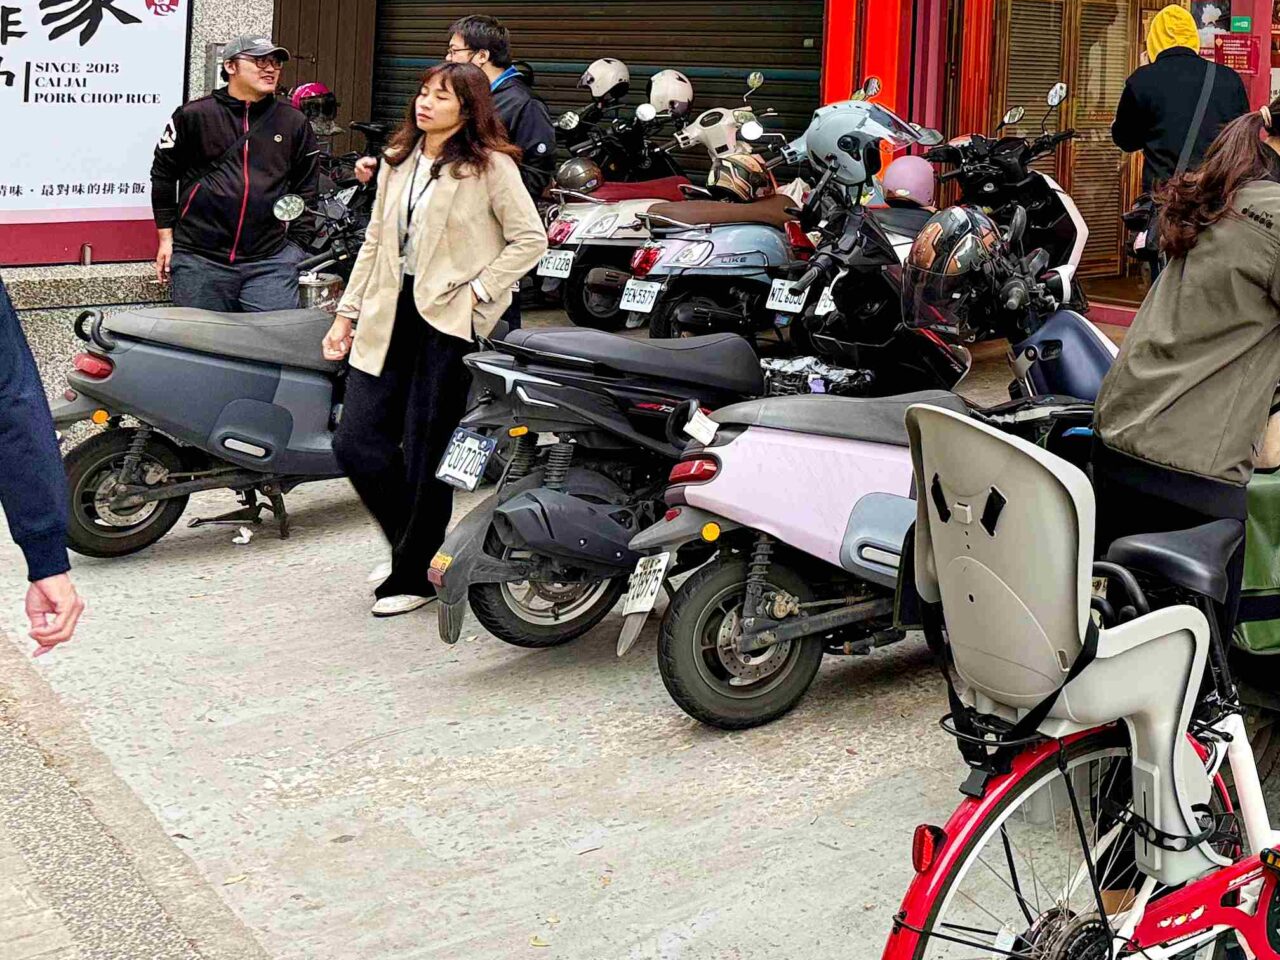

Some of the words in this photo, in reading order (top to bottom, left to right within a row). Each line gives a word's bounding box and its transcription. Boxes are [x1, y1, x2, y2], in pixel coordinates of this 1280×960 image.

[35, 62, 80, 73] SINCE
[86, 62, 119, 74] 2013
[35, 77, 61, 88] CAI
[64, 77, 87, 88] JAI
[34, 92, 77, 104] PORK
[81, 93, 123, 104] CHOP
[125, 93, 161, 104] RICE
